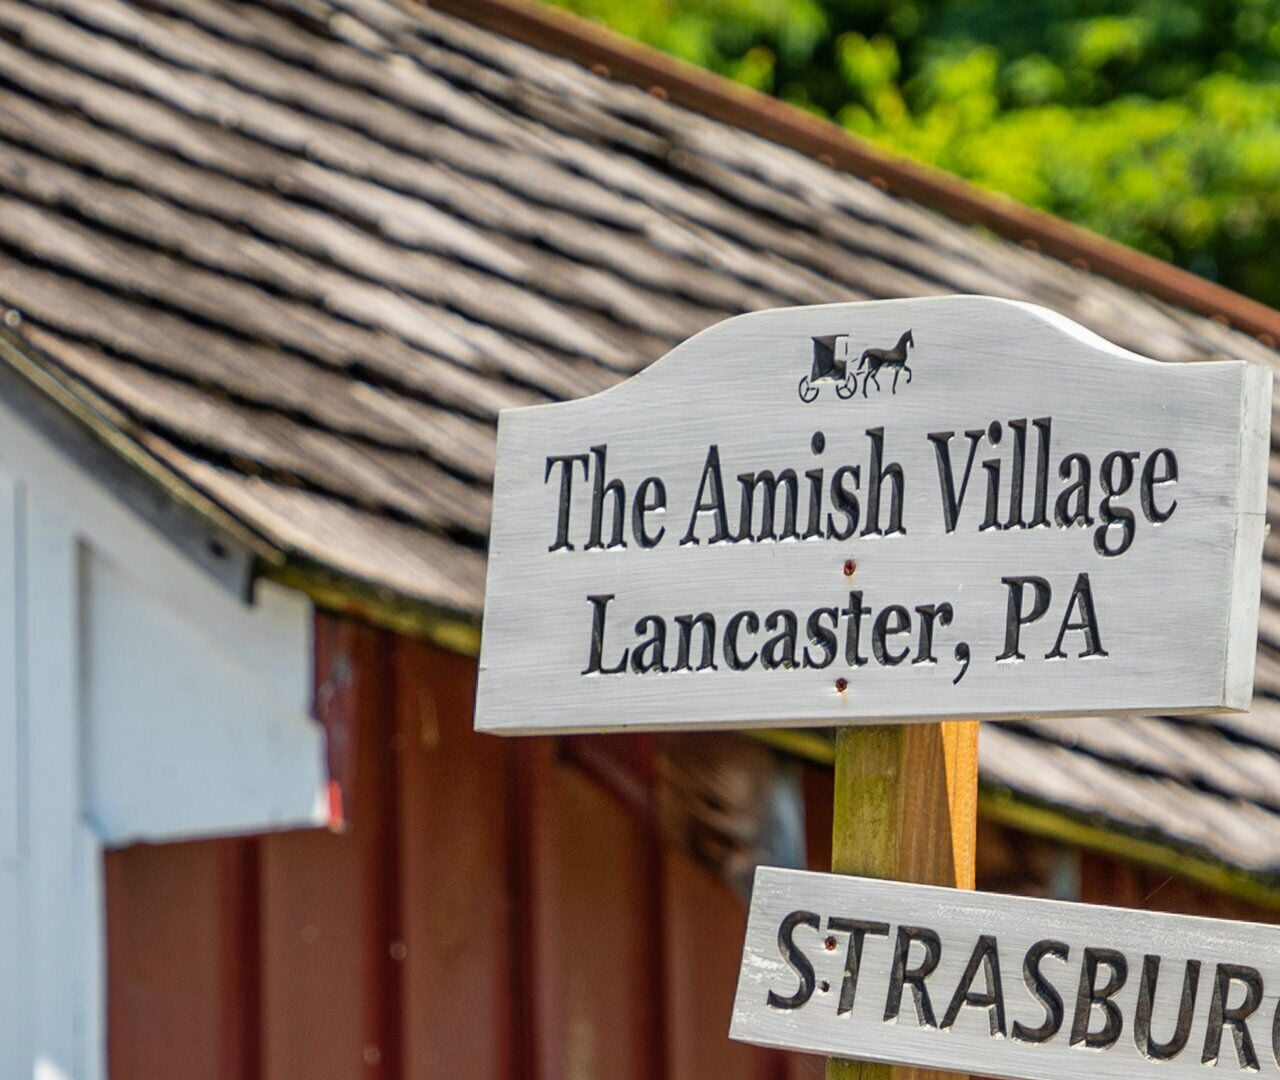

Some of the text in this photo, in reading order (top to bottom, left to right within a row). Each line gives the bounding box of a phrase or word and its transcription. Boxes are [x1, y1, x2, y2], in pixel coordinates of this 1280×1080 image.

[544, 416, 1180, 557] The Amish Village
[581, 572, 1110, 685] Lancaster, PA
